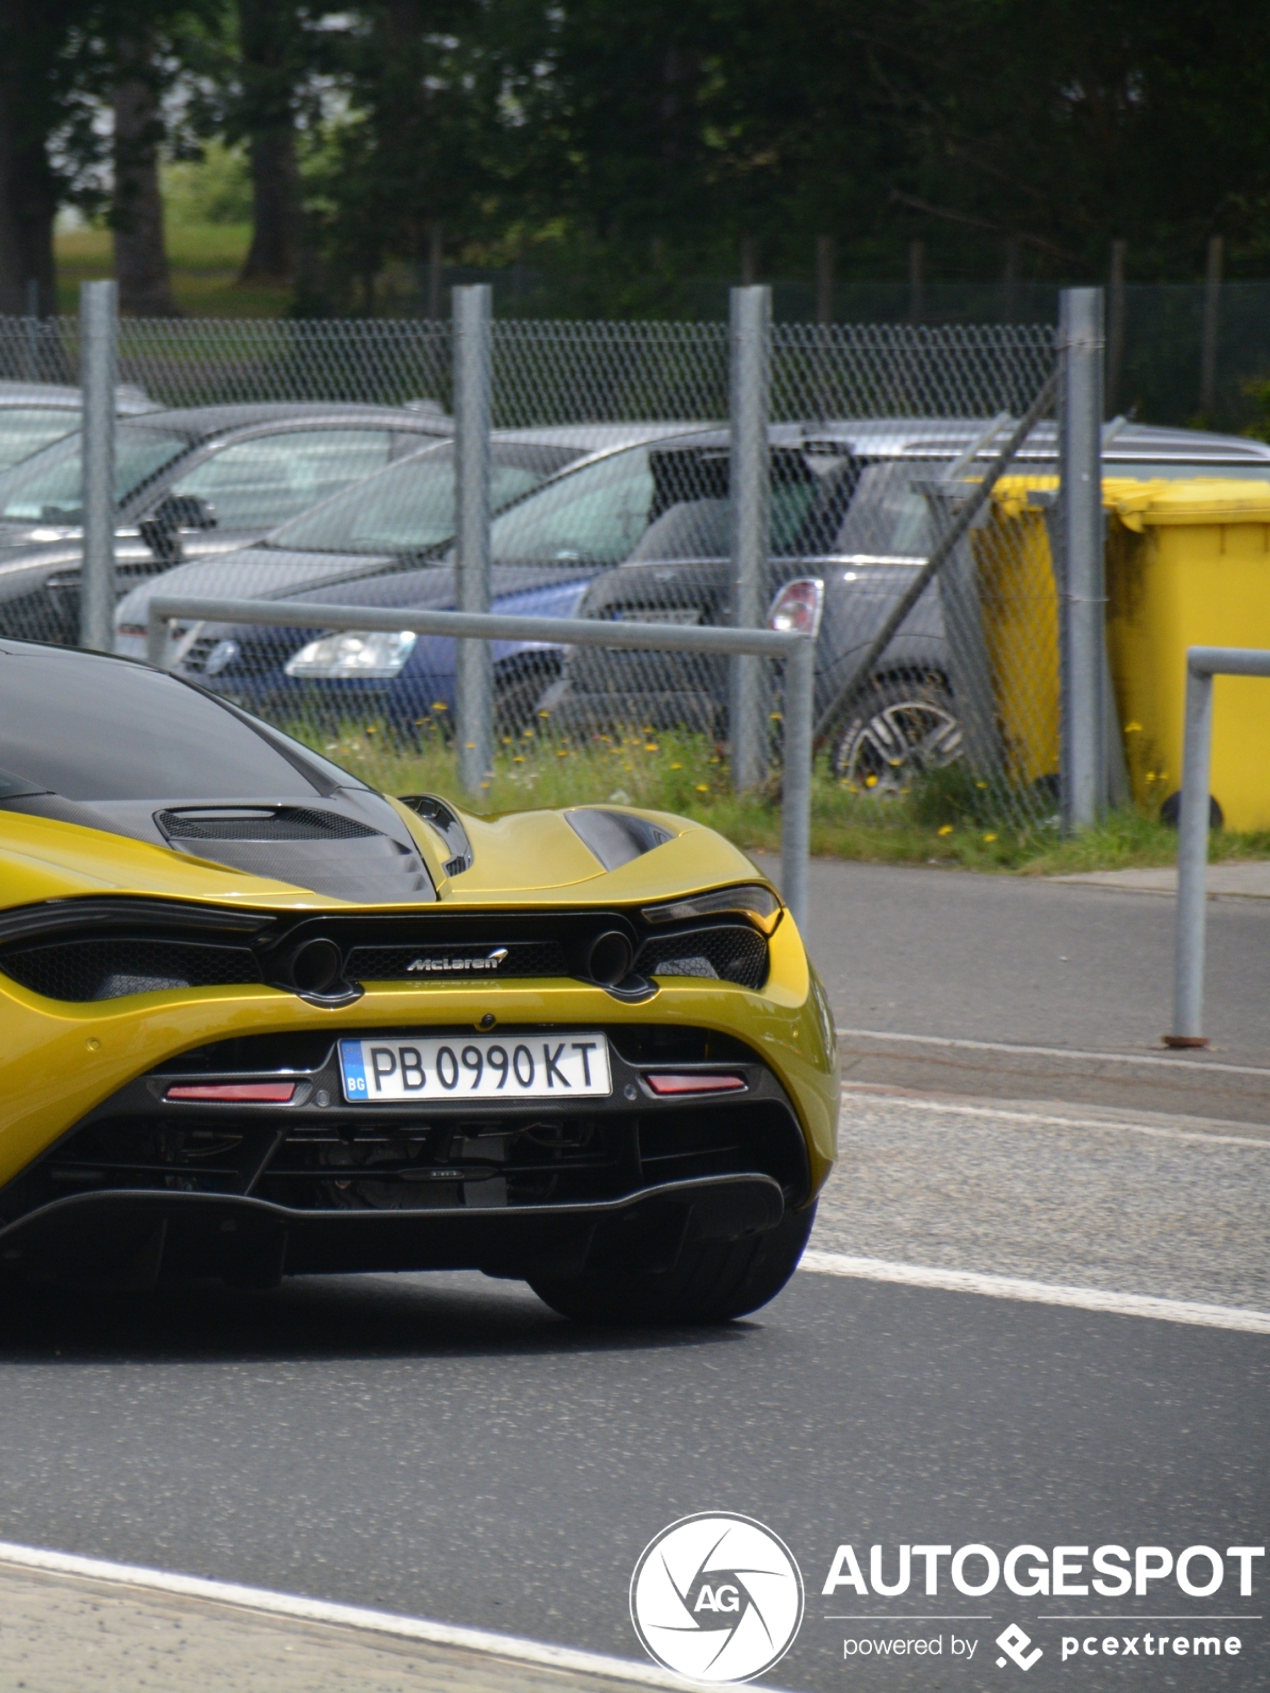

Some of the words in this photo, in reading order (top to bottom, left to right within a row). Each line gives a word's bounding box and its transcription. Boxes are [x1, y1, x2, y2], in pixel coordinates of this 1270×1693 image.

[407, 958, 498, 971] McLaren
[369, 1046, 427, 1092] PB
[435, 1044, 535, 1090] 0990
[543, 1042, 597, 1088] KT
[347, 1077, 366, 1092] BG
